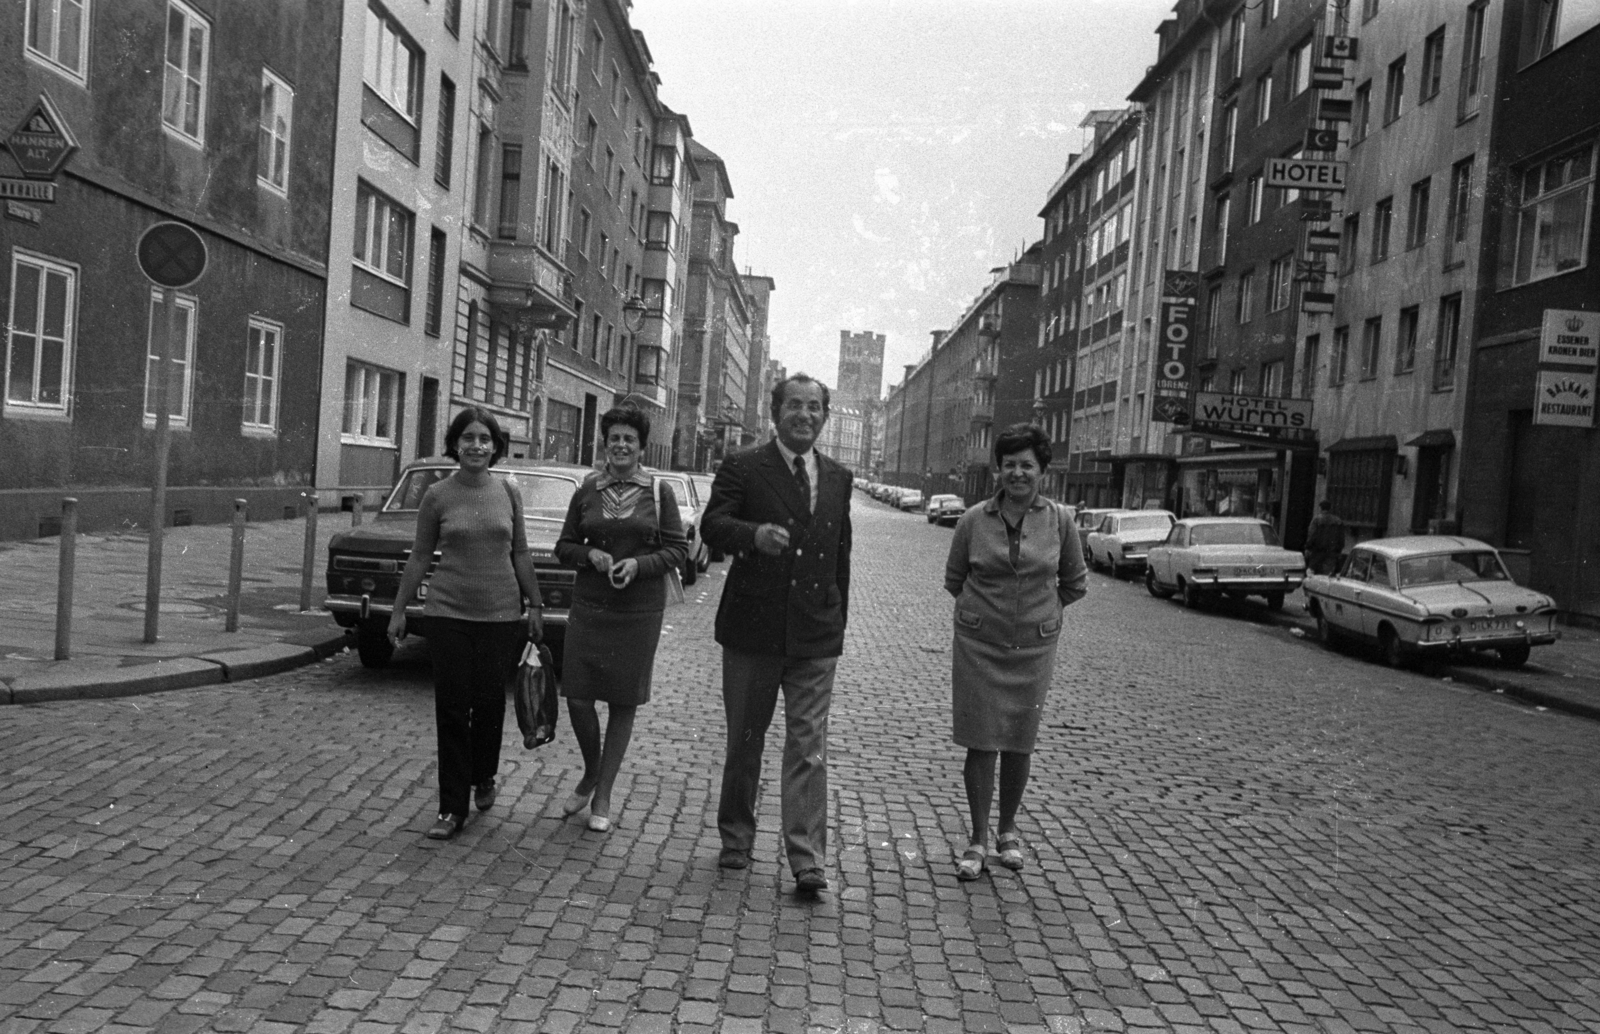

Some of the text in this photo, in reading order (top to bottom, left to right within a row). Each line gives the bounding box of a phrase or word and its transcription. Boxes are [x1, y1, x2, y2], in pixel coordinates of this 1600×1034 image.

[11, 135, 65, 149] HANNEN
[1272, 162, 1342, 184] HOTEL
[1163, 306, 1189, 379] FOTO
[1557, 334, 1589, 345] ESSENER
[1548, 345, 1596, 357] KRONEN BIER
[1157, 379, 1189, 390] LORENZ
[1221, 397, 1287, 410] HOTEL
[1541, 402, 1592, 416] RESTAURANT
